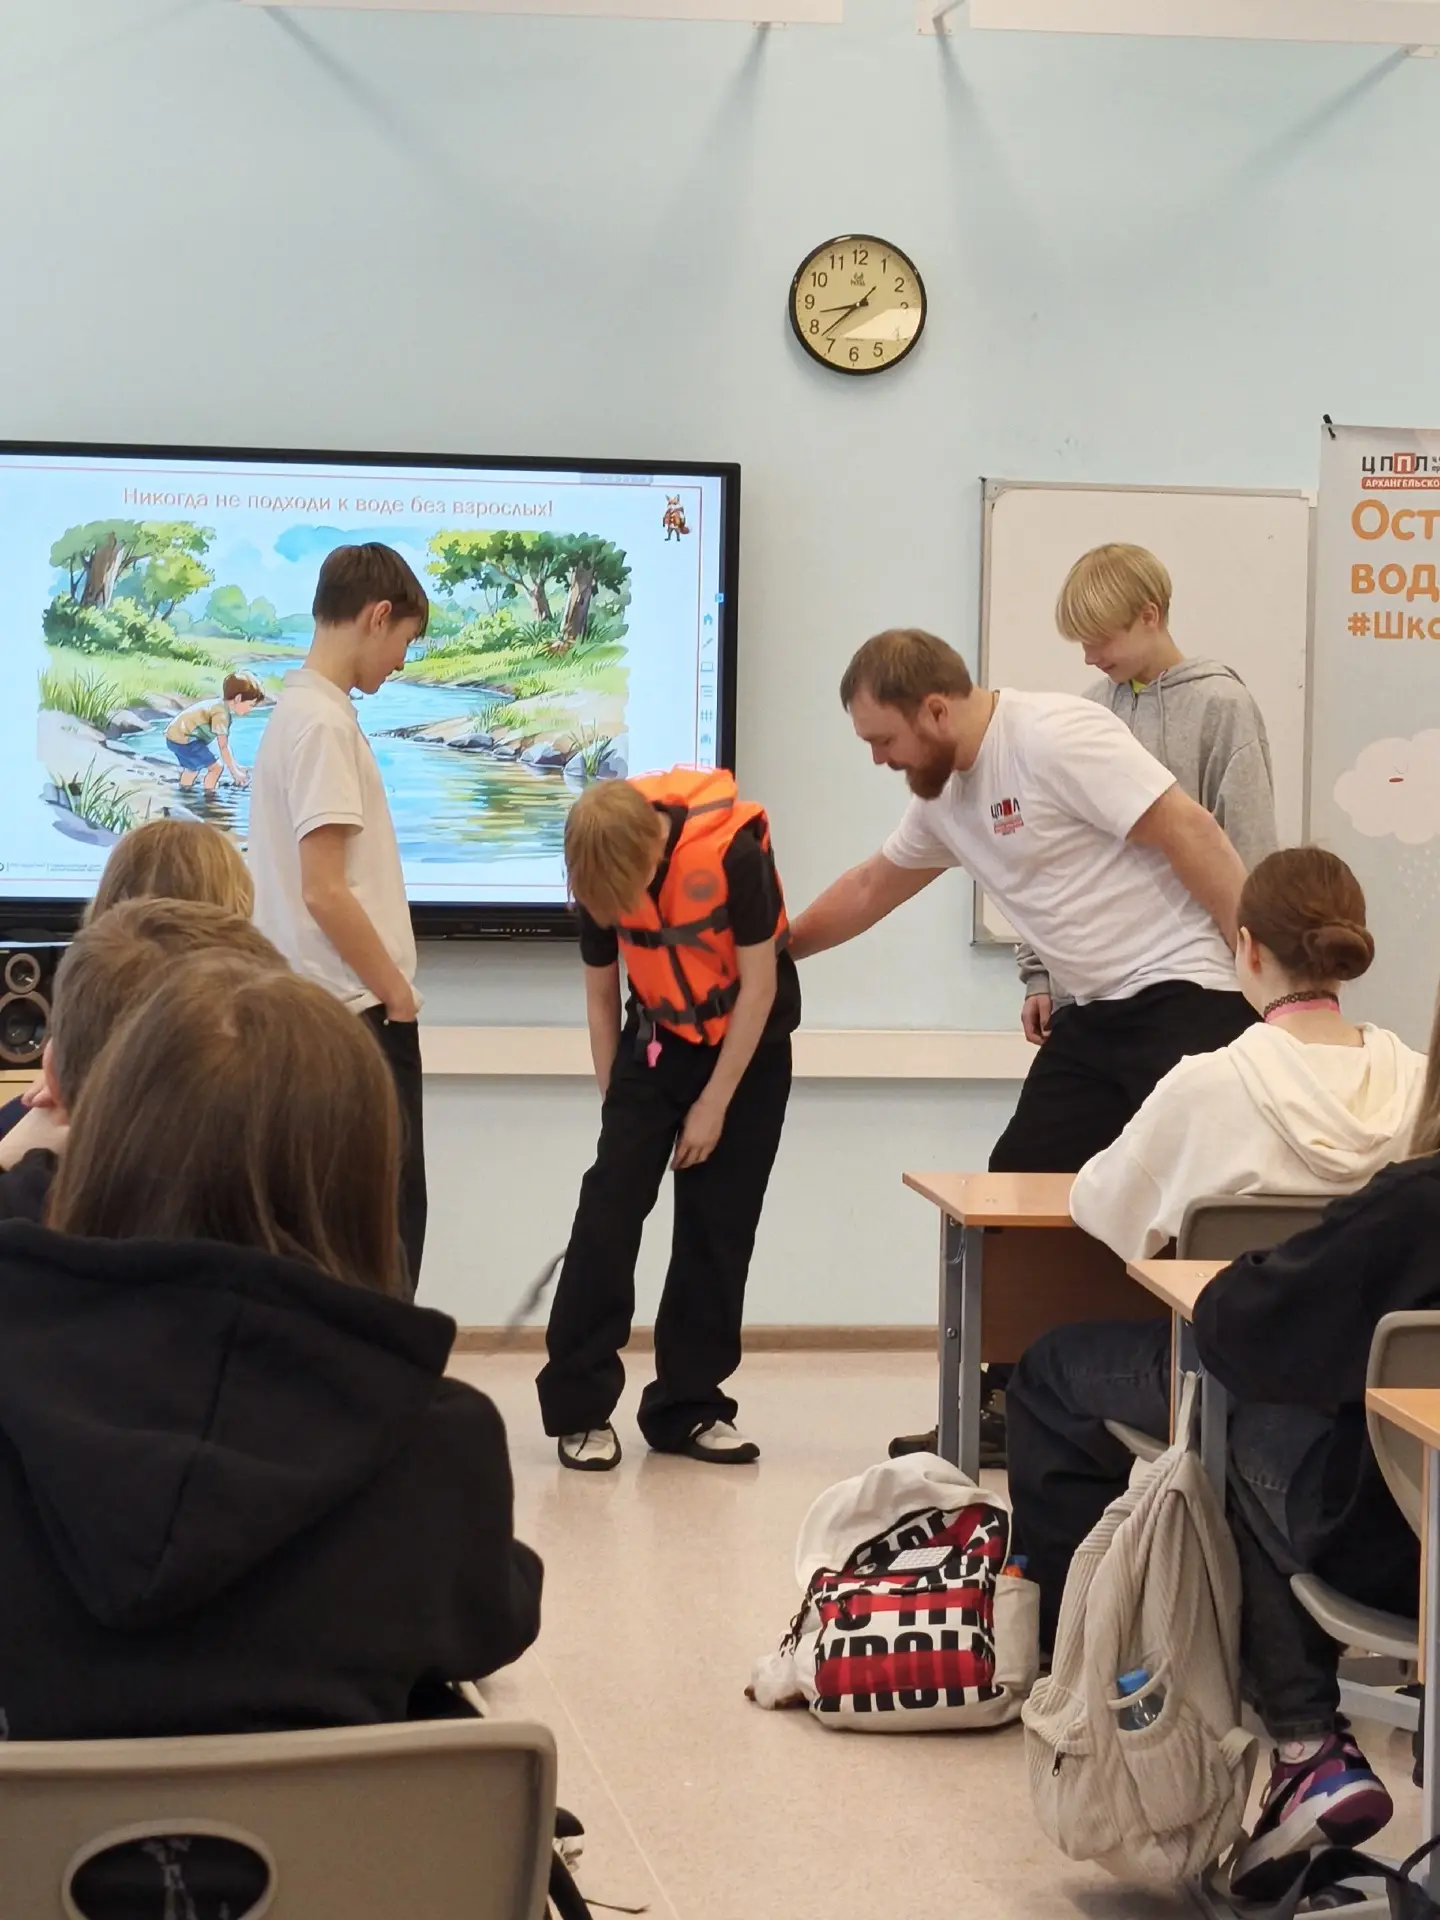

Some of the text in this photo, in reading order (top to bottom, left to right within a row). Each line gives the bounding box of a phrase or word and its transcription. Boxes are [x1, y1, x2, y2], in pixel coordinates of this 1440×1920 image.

[830, 254, 844, 270] 11
[852, 249, 869, 265] 12
[880, 258, 887, 274] 1
[811, 271, 828, 287] 10
[894, 276, 905, 292] 2
[804, 294, 815, 310] 9
[809, 319, 820, 334] 8
[826, 337, 836, 353] 7
[873, 342, 883, 357] 5
[849, 346, 859, 362] 6
[1362, 453, 1428, 474] ЦППЛ
[123, 487, 553, 518] Никогда не подходи к воде без взрослых!
[1352, 499, 1440, 540] Ост
[1352, 563, 1440, 602] вод
